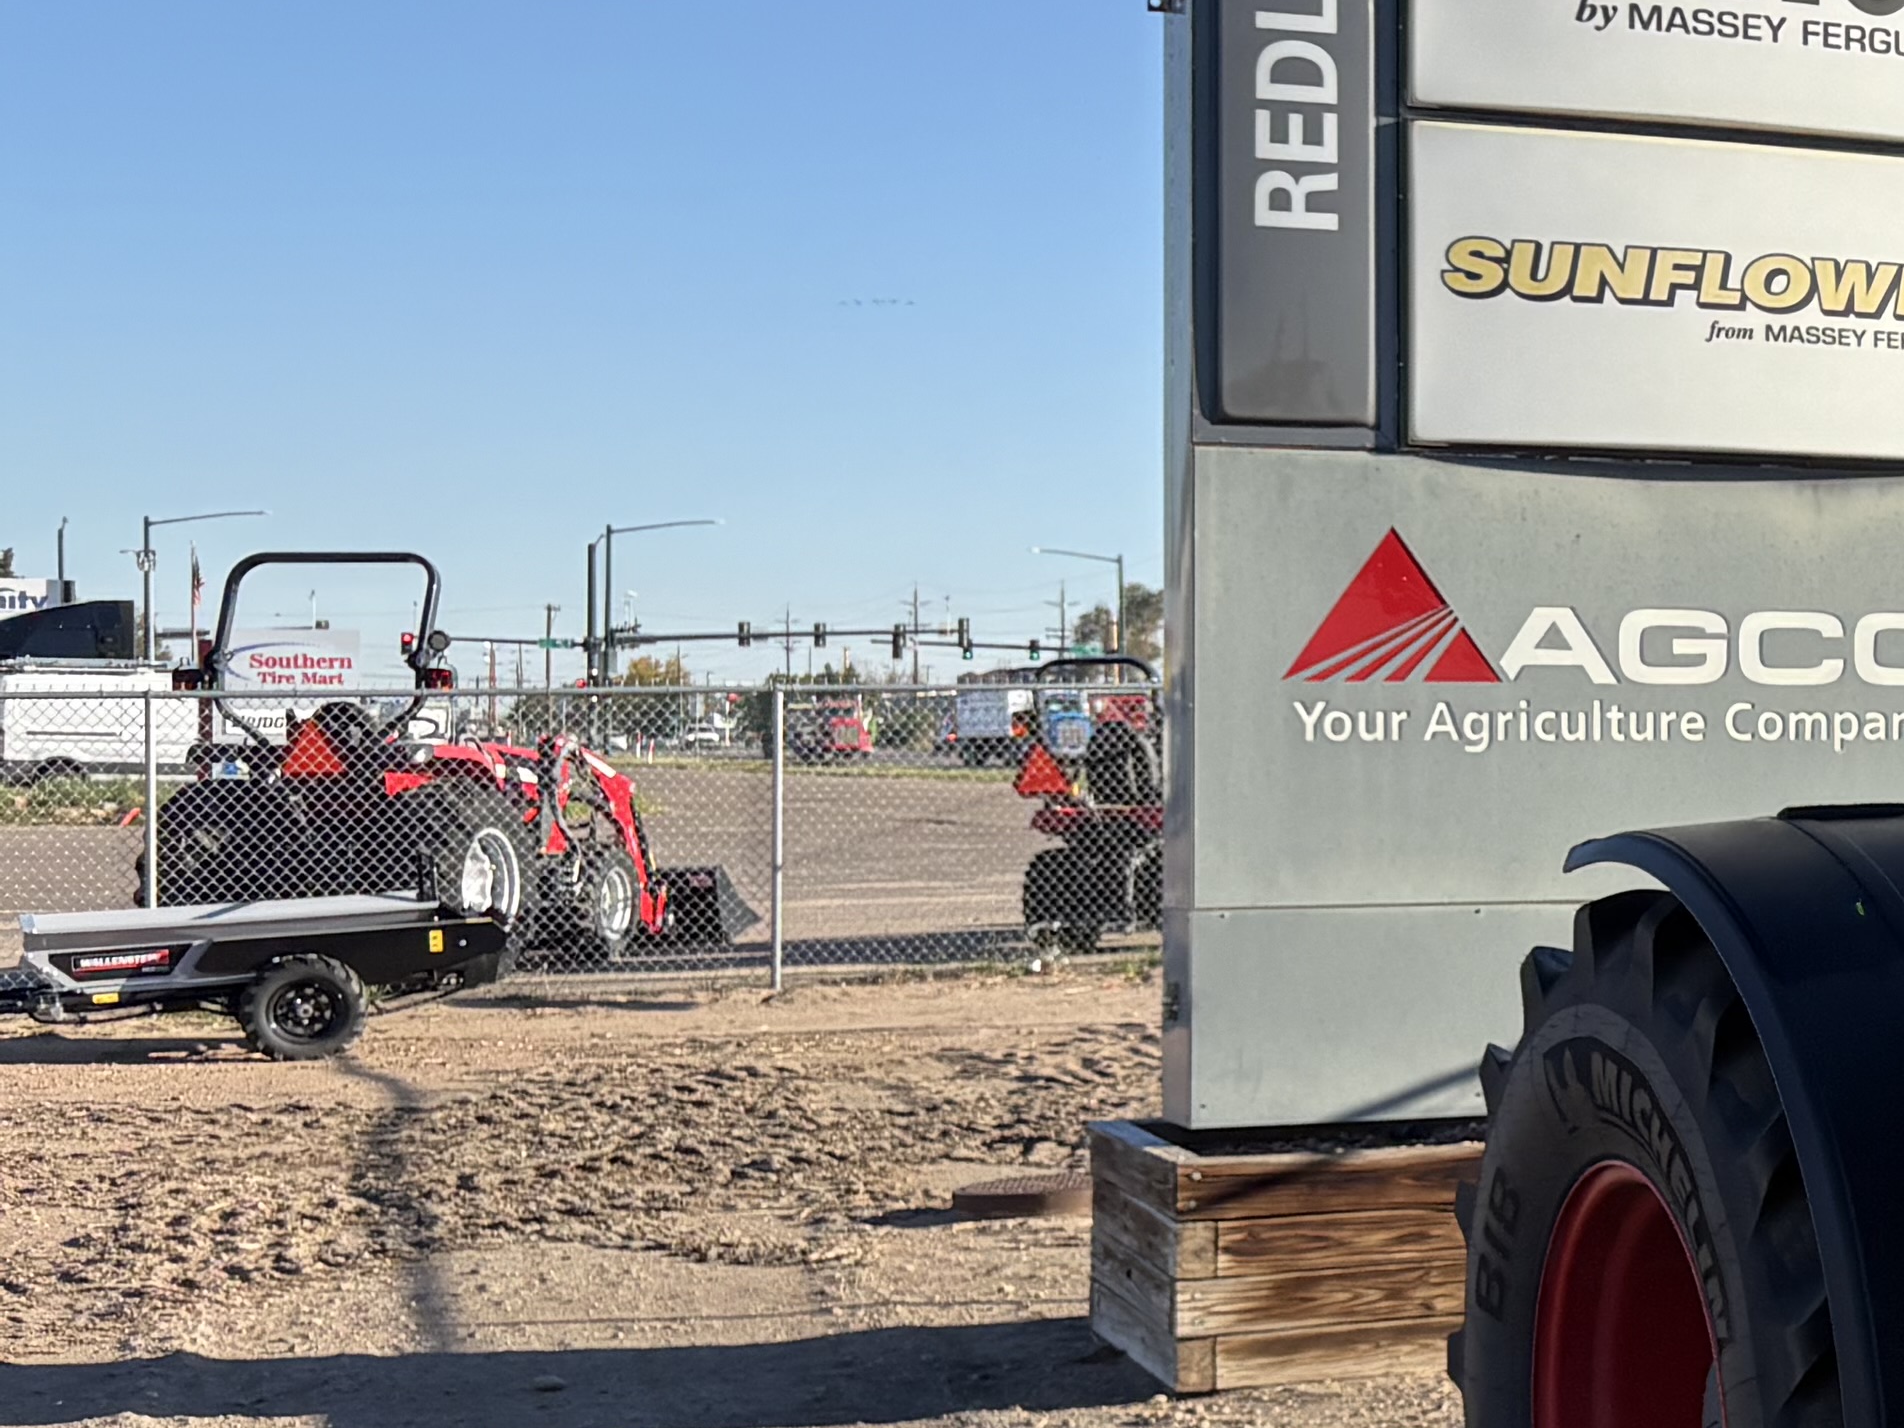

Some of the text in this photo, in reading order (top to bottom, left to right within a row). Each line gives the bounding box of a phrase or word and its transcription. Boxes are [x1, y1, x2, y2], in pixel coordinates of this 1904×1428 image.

[1627, 2, 1786, 44] MASSEY
[1705, 320, 1755, 346] from
[1764, 323, 1866, 348] MASSEY
[249, 653, 353, 669] Southern
[257, 671, 344, 685] Tire Mart
[1293, 700, 1409, 743] Your
[1424, 700, 1706, 753] Agriculture
